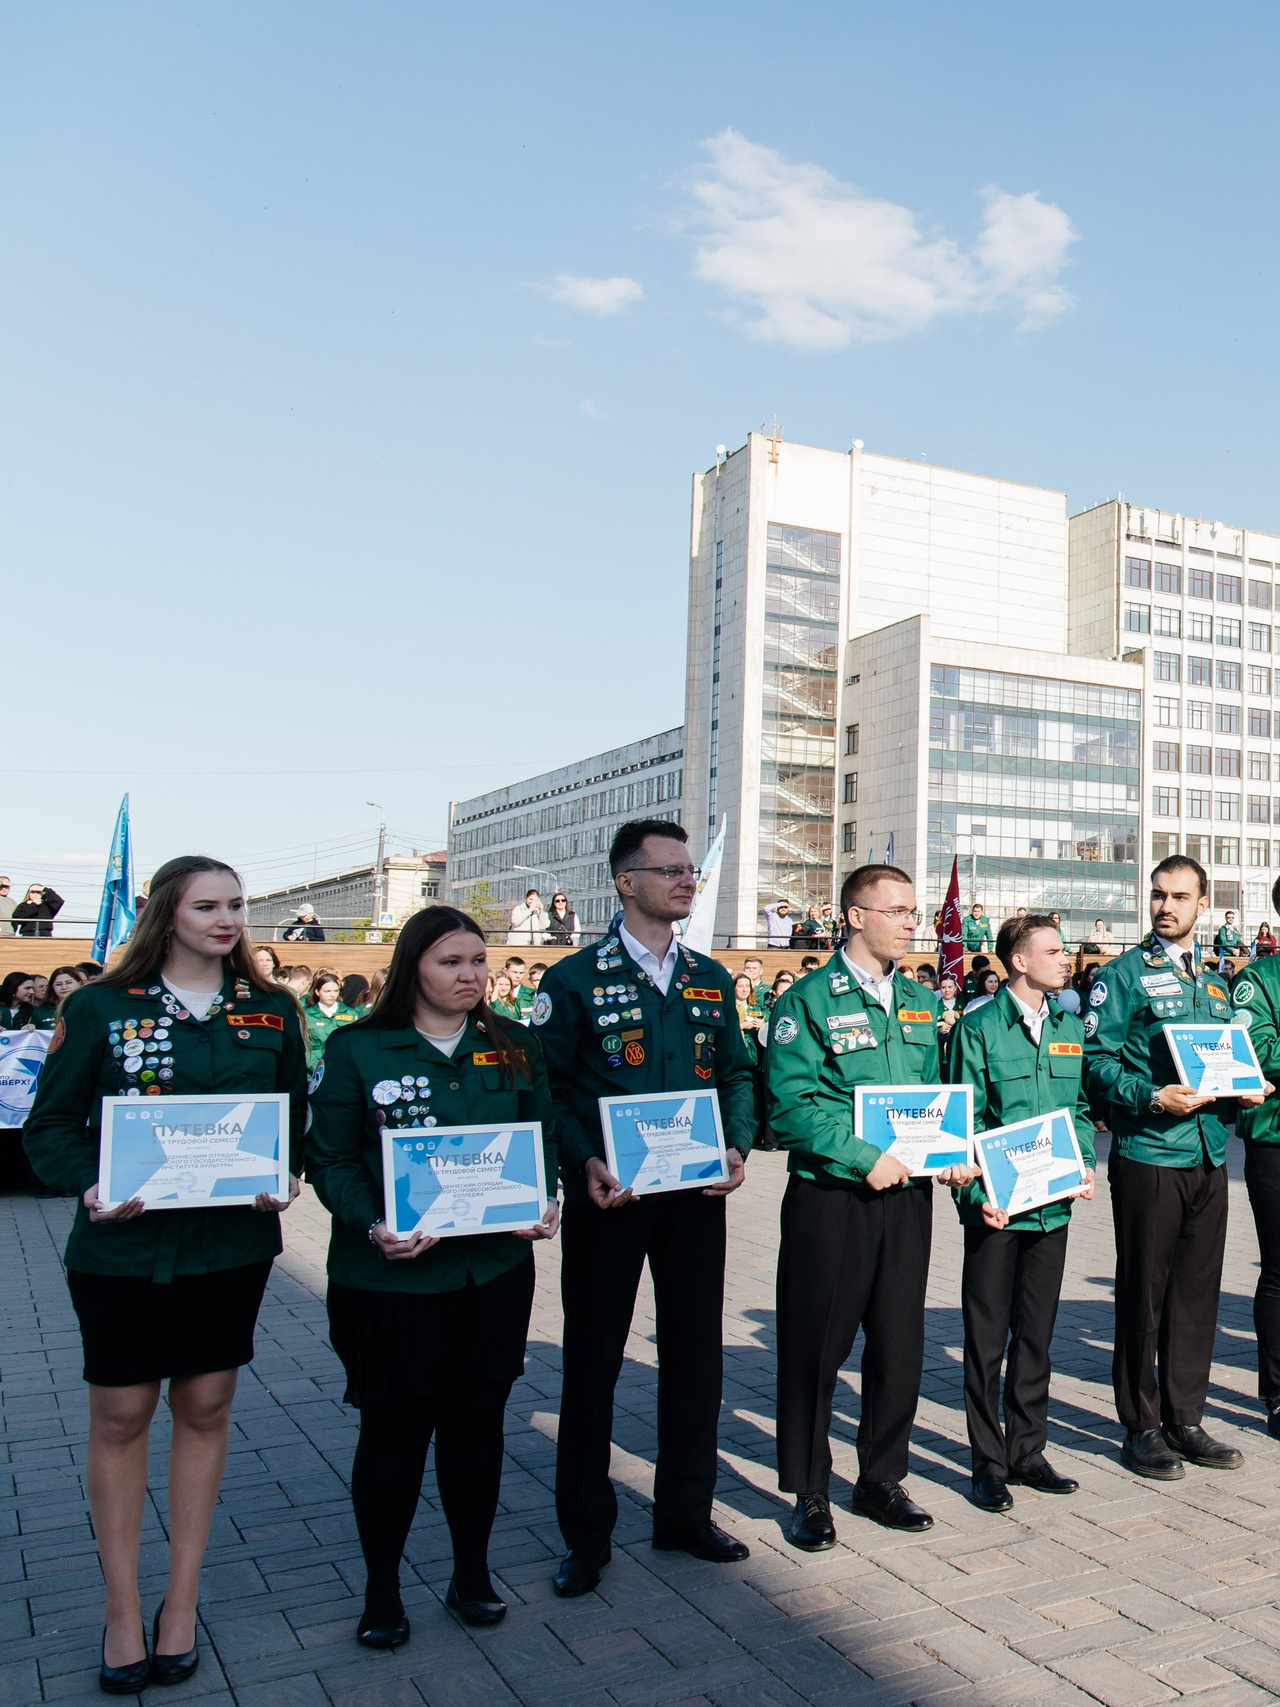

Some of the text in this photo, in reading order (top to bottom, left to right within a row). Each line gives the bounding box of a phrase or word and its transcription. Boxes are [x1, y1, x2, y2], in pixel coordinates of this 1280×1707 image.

[1191, 1042, 1232, 1052] ПУТЕВКА
[886, 1108, 944, 1119] ПУТЕВКА
[152, 1122, 243, 1137] ПУТЕВКА
[635, 1116, 692, 1132] ПУТЕВКА
[167, 1137, 208, 1145] ТРУДОВОЙ
[1003, 1137, 1053, 1159] ПУТЕВКА
[427, 1151, 505, 1168] ПУТЕВКА
[441, 1167, 476, 1175] ТРУДОВОЙ
[458, 1184, 522, 1193] ПРОФЕССИОНАЛЬНОГО
